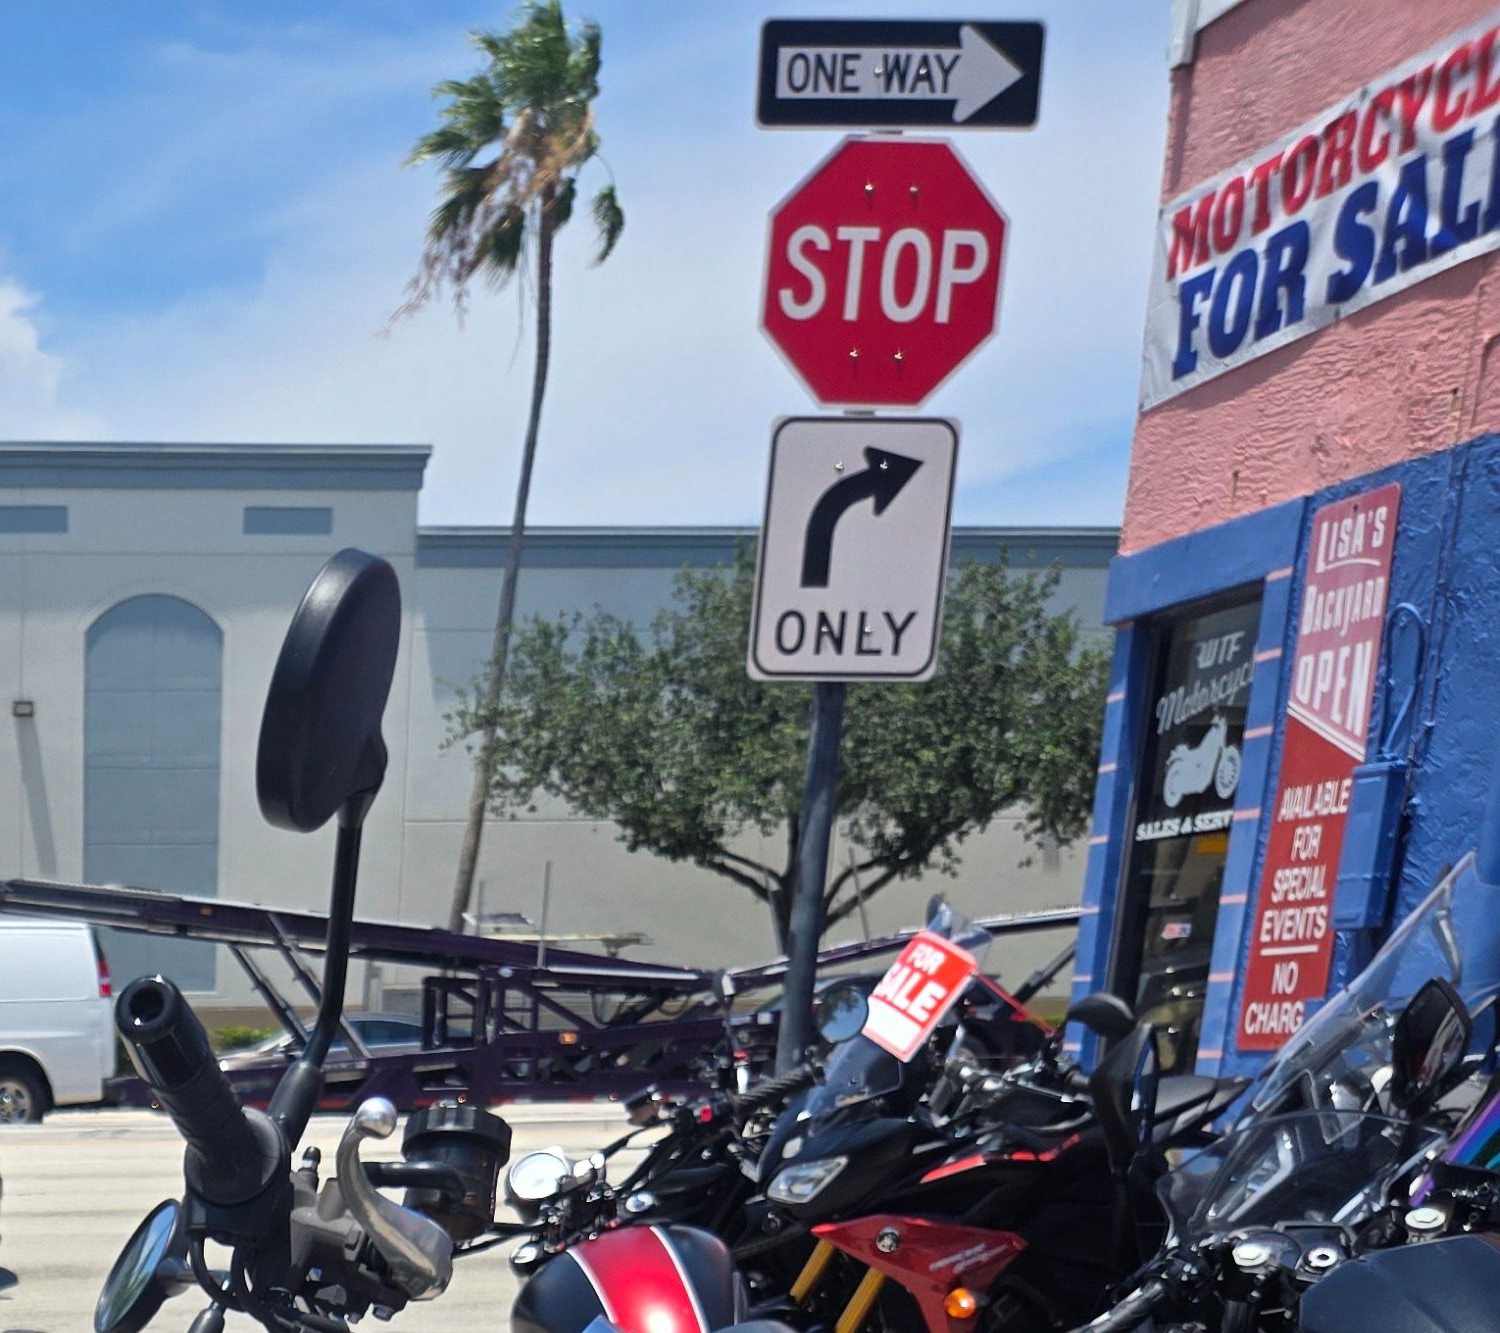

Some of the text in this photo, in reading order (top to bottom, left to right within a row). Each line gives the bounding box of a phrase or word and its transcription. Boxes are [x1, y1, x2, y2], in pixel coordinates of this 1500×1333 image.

[786, 52, 960, 96] ONE WAY
[777, 224, 989, 324] STOP
[1171, 220, 1310, 381] FOR
[1315, 506, 1387, 574] LISA'S
[774, 610, 918, 656] ONLY
[1299, 640, 1373, 738] OPEN
[1135, 817, 1181, 842] SALES
[1290, 825, 1322, 861] FOR
[1271, 865, 1327, 903] SPECIAL
[1260, 905, 1328, 942] EVENTS
[906, 943, 946, 976] FOR
[1271, 961, 1299, 995] NO
